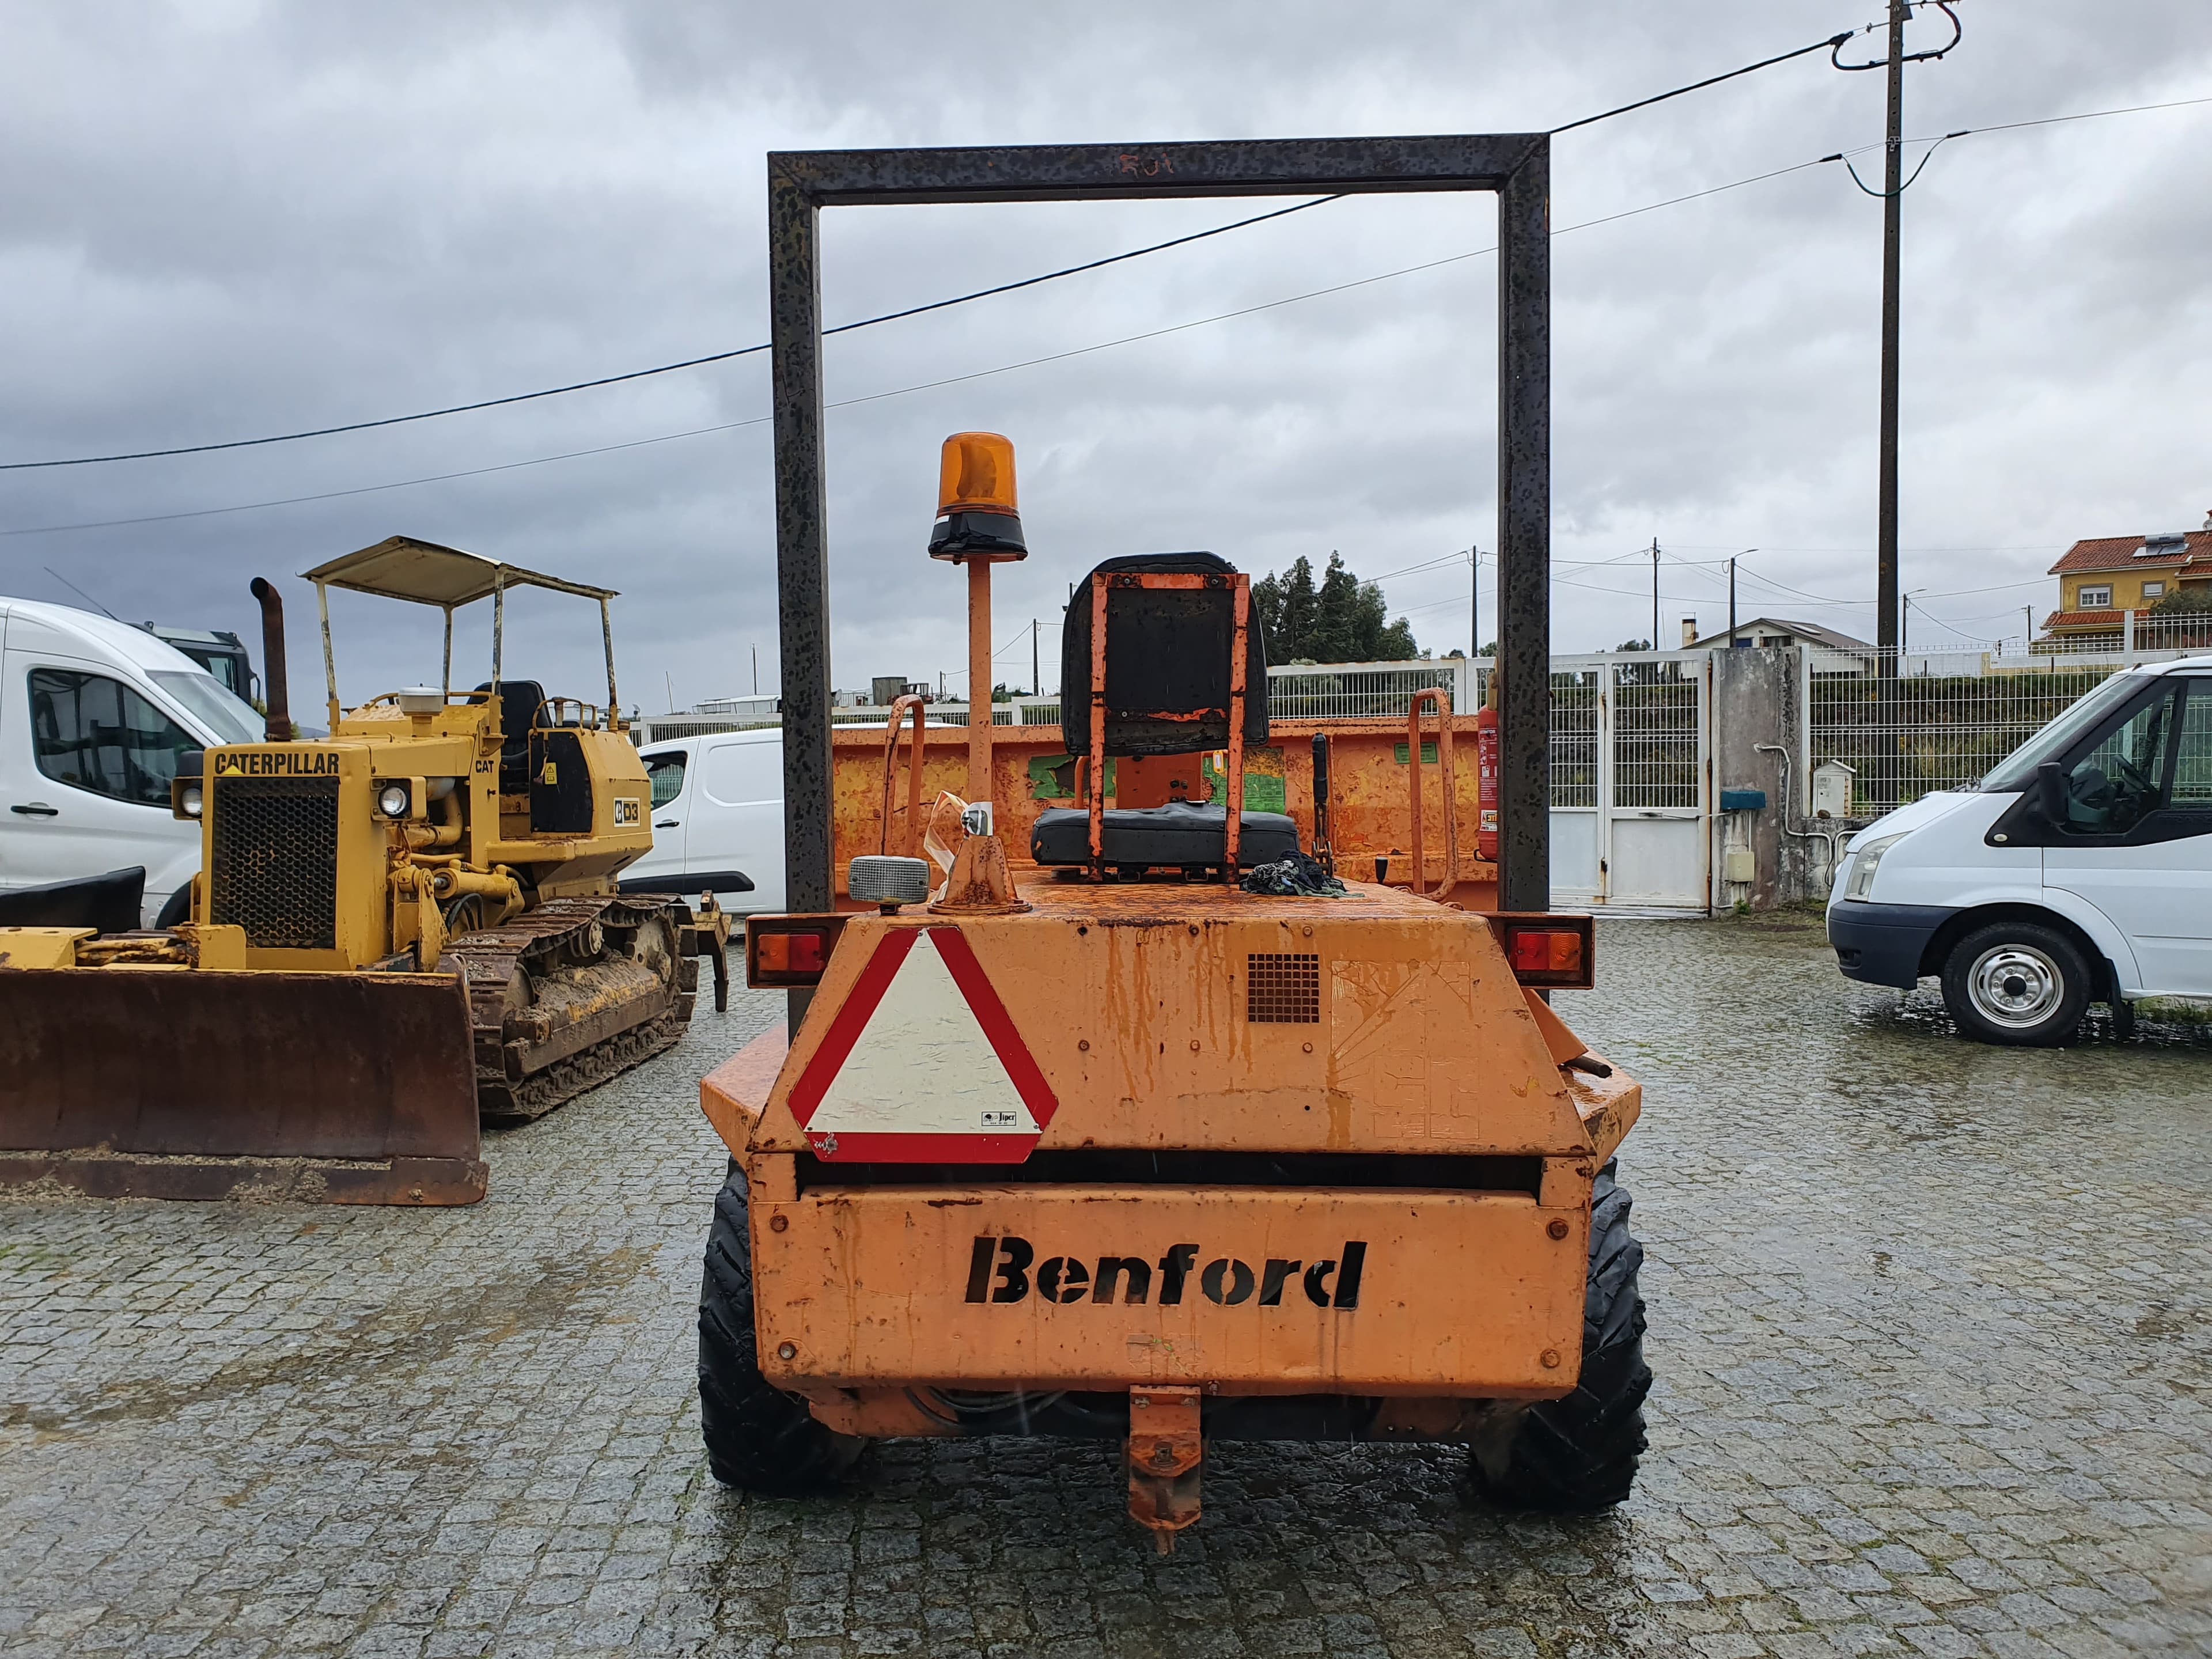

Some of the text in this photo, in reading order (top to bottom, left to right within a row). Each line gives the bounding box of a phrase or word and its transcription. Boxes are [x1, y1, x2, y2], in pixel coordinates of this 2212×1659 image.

[215, 753, 339, 774] CATERPILLAR
[476, 760, 494, 773] CAT
[965, 1236, 1368, 1309] Benford
